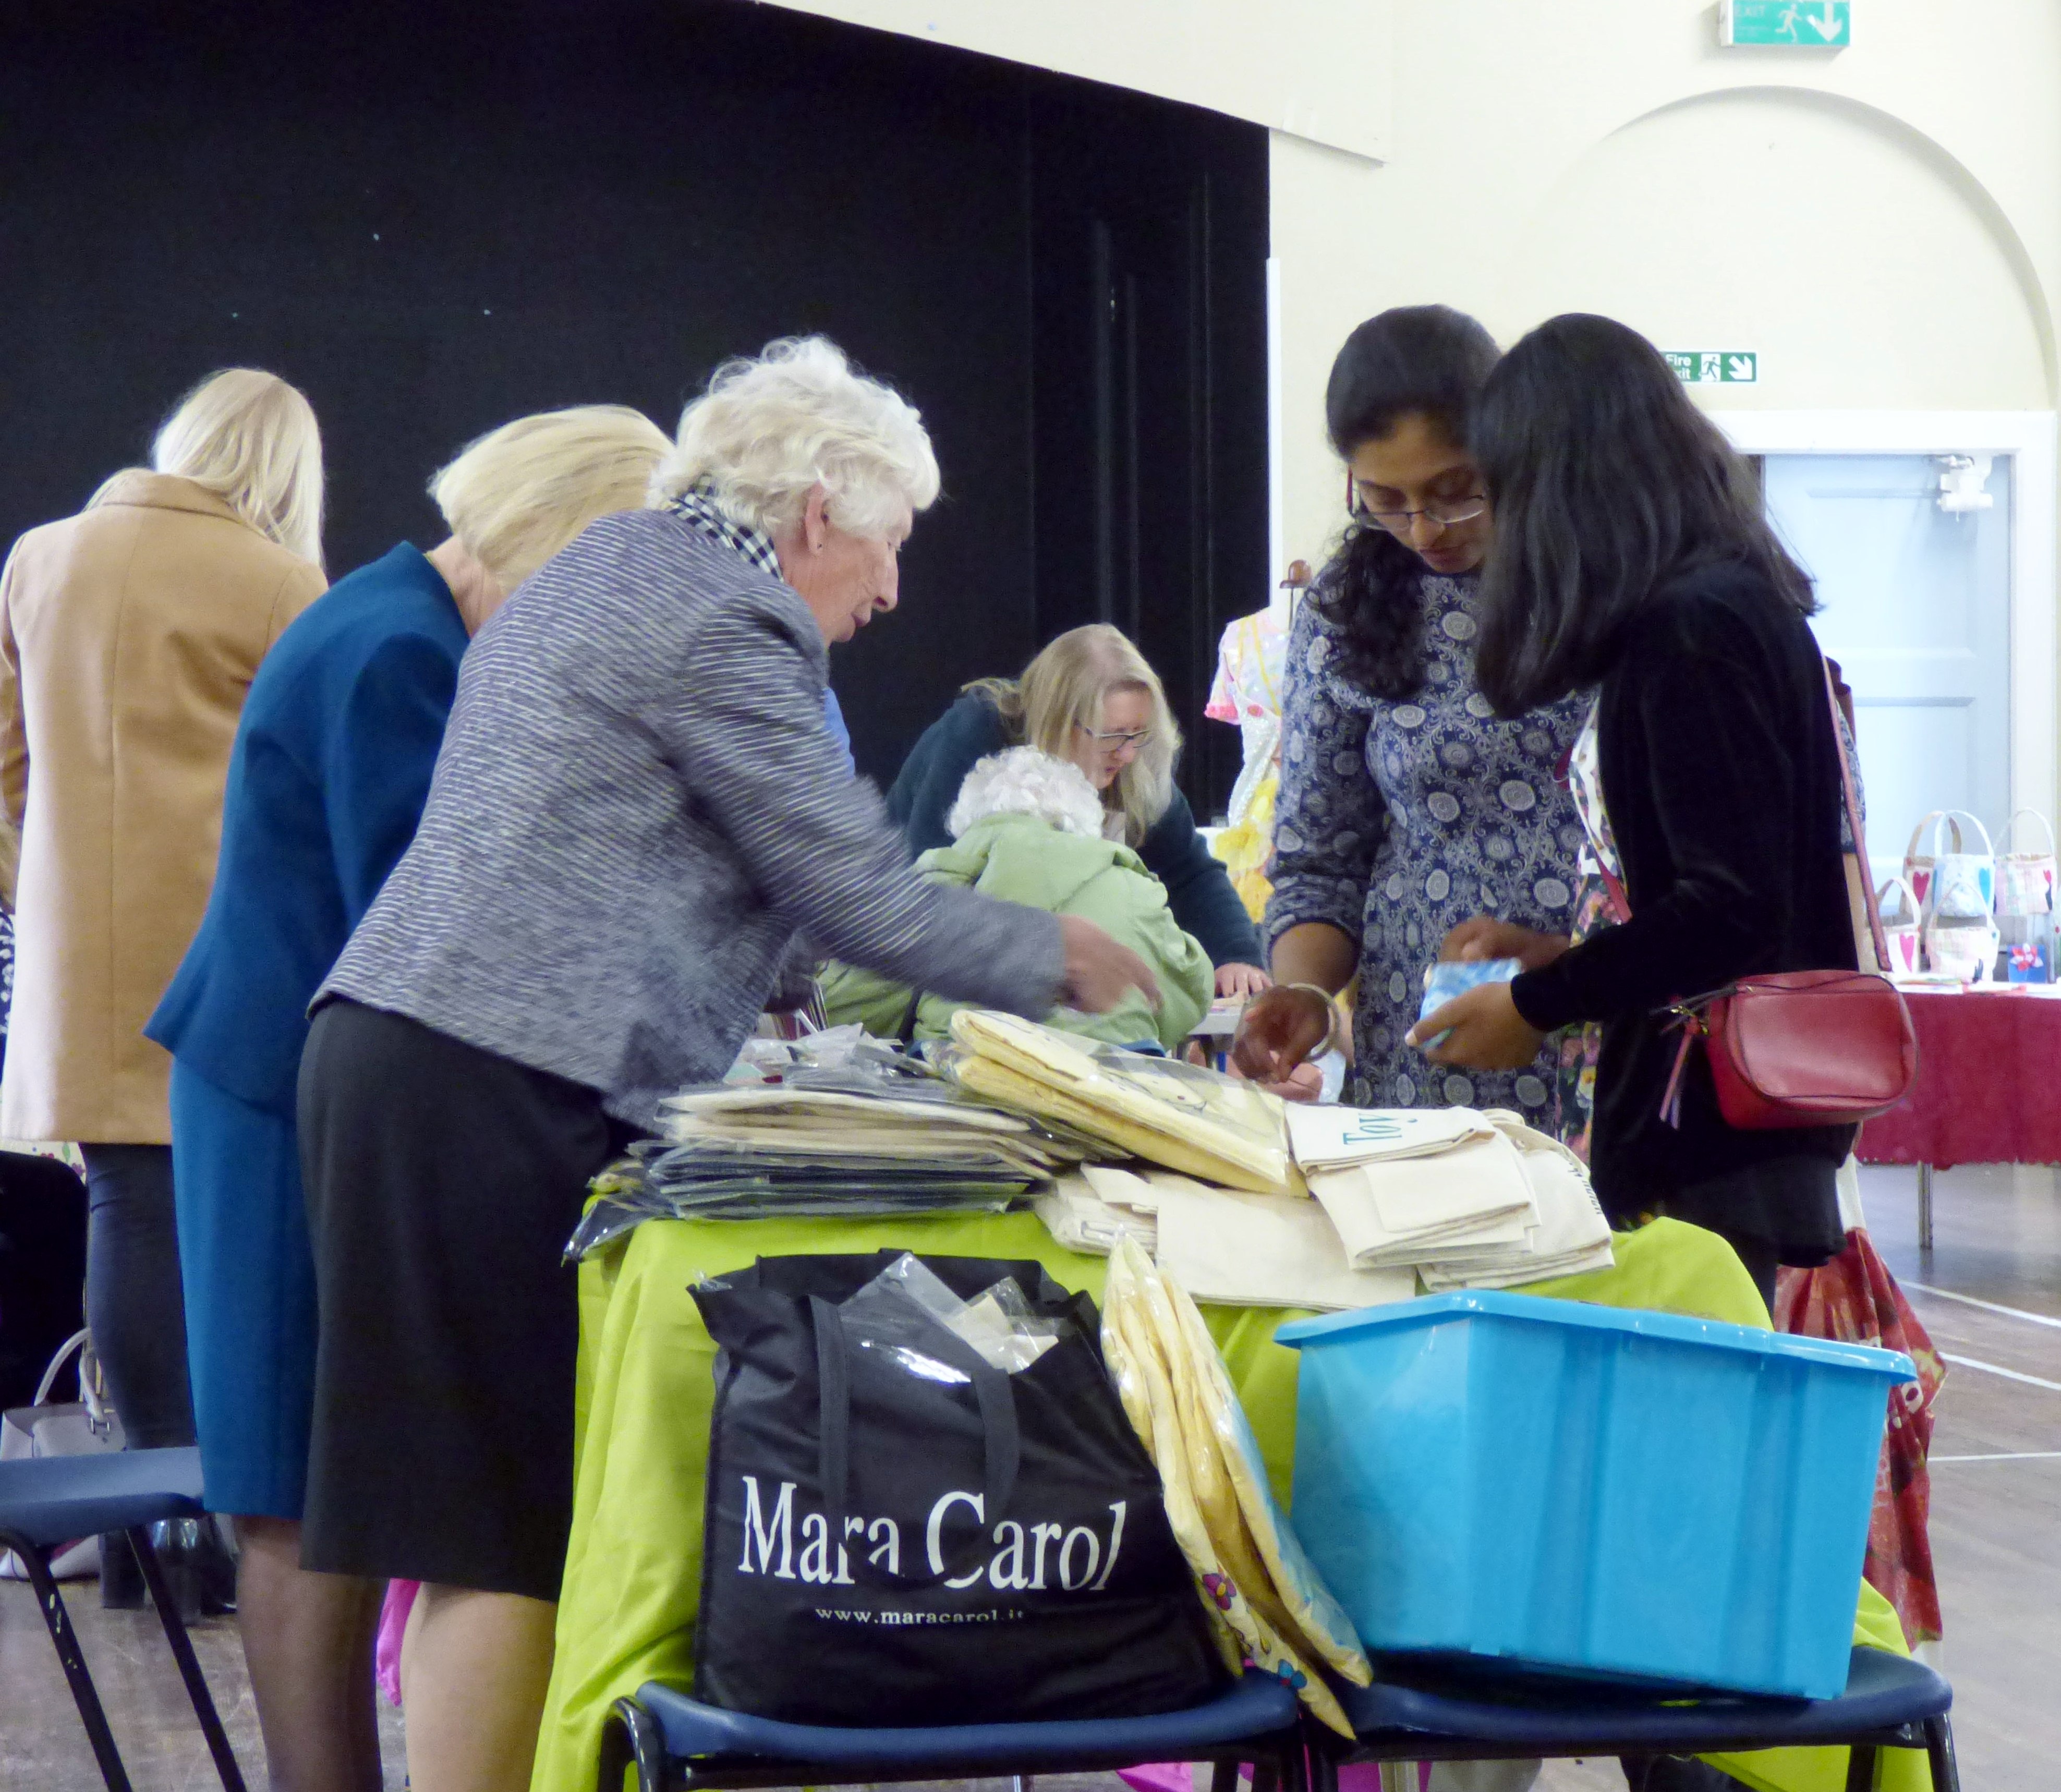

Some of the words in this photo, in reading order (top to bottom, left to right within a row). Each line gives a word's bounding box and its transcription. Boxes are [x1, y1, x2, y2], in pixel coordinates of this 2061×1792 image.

[1666, 354, 1692, 367] Fire
[1673, 367, 1691, 380] xit
[737, 1475, 905, 1584] Mara
[926, 1491, 1126, 1592] Carol
[814, 1607, 1024, 1625] www.maracarol.it
